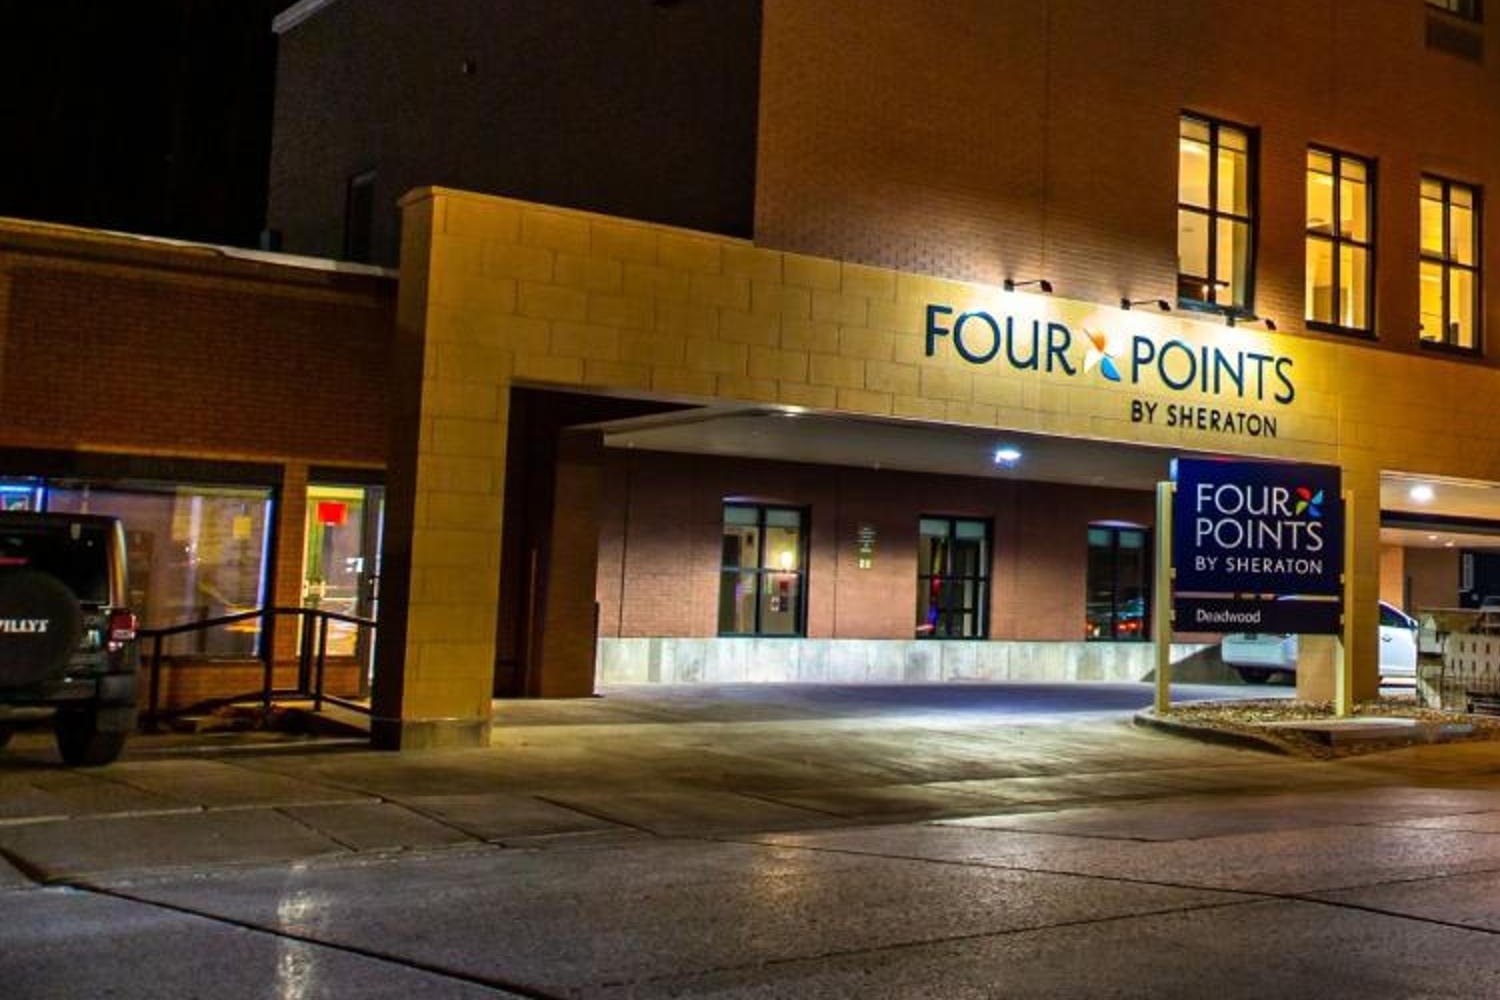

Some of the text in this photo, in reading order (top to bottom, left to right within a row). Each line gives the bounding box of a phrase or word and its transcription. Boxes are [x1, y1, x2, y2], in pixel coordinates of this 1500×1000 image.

[924, 304, 1295, 405] FOUR POINTS
[1131, 400, 1278, 438] BY SHERATON
[1196, 483, 1292, 517] FOUR
[1196, 518, 1324, 551] POINTS
[1195, 555, 1323, 574] BY SHERATON
[1197, 609, 1262, 624] Deadwood
